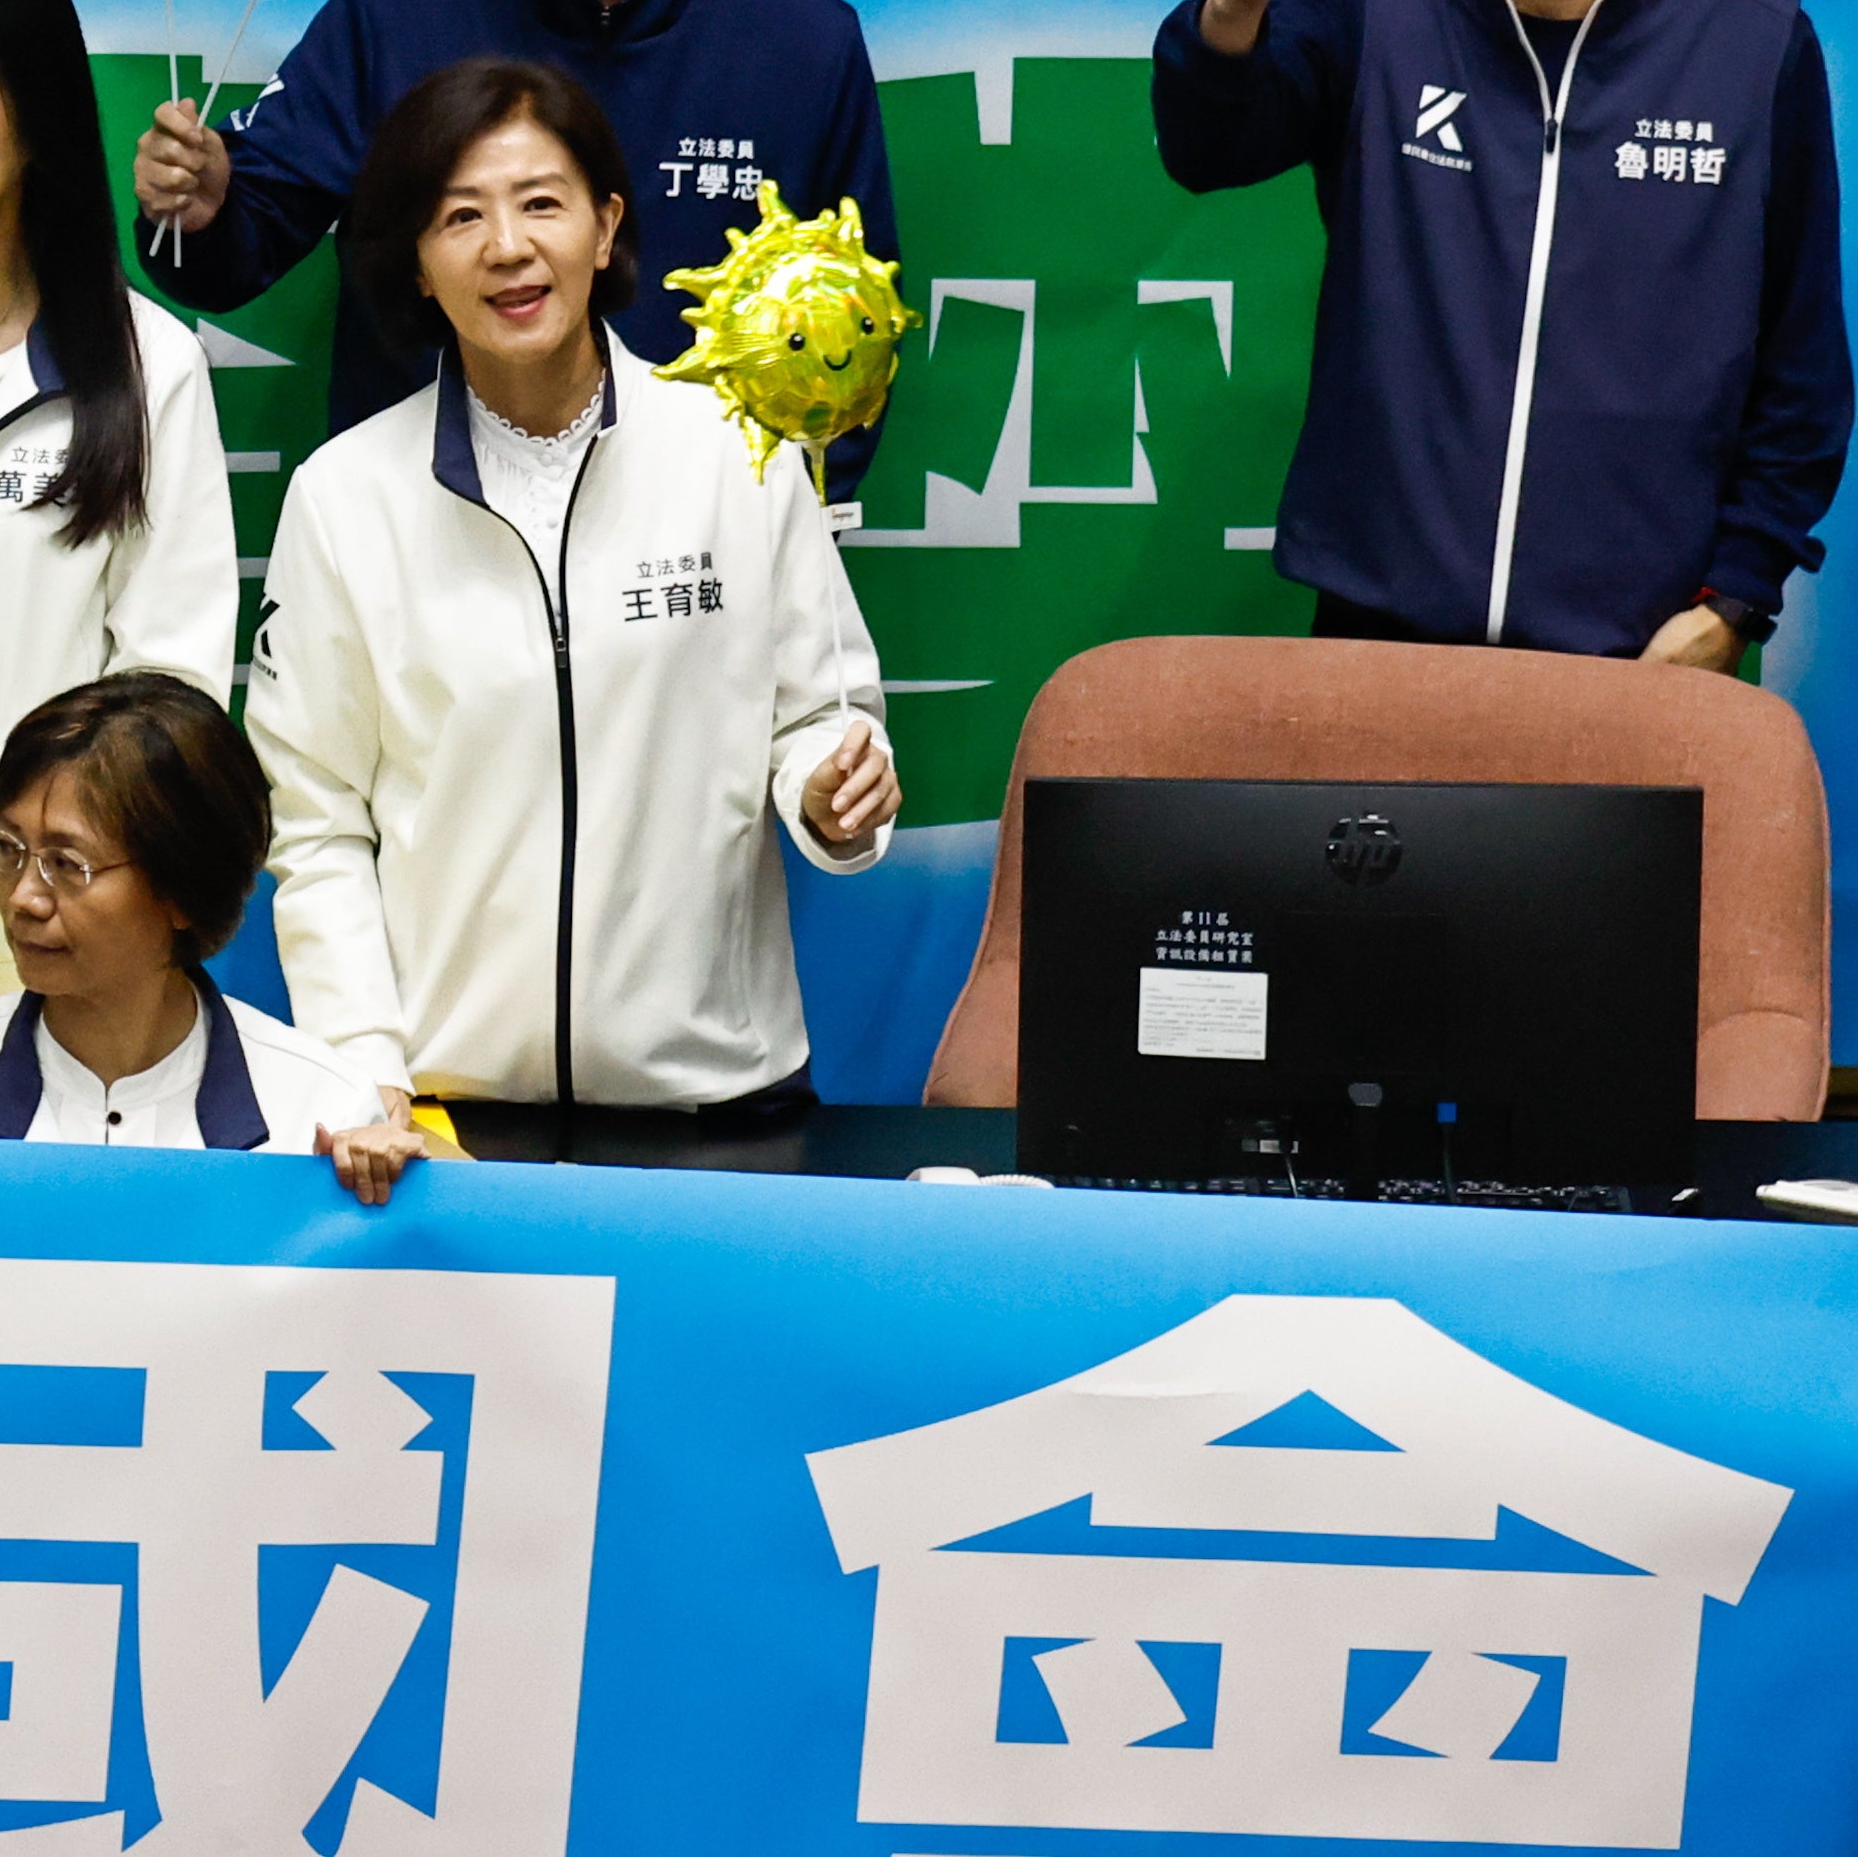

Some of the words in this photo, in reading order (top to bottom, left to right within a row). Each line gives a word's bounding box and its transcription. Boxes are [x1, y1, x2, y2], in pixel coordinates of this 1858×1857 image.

[1635, 118, 1713, 142] 立法委員
[678, 136, 755, 160] 立法委員
[1614, 142, 1726, 184] 魯明哲
[659, 162, 763, 201] 丁學忠
[637, 551, 712, 578] 立法委員
[622, 577, 723, 622] 王育敏
[1156, 929, 1253, 946] 立法委員研究室
